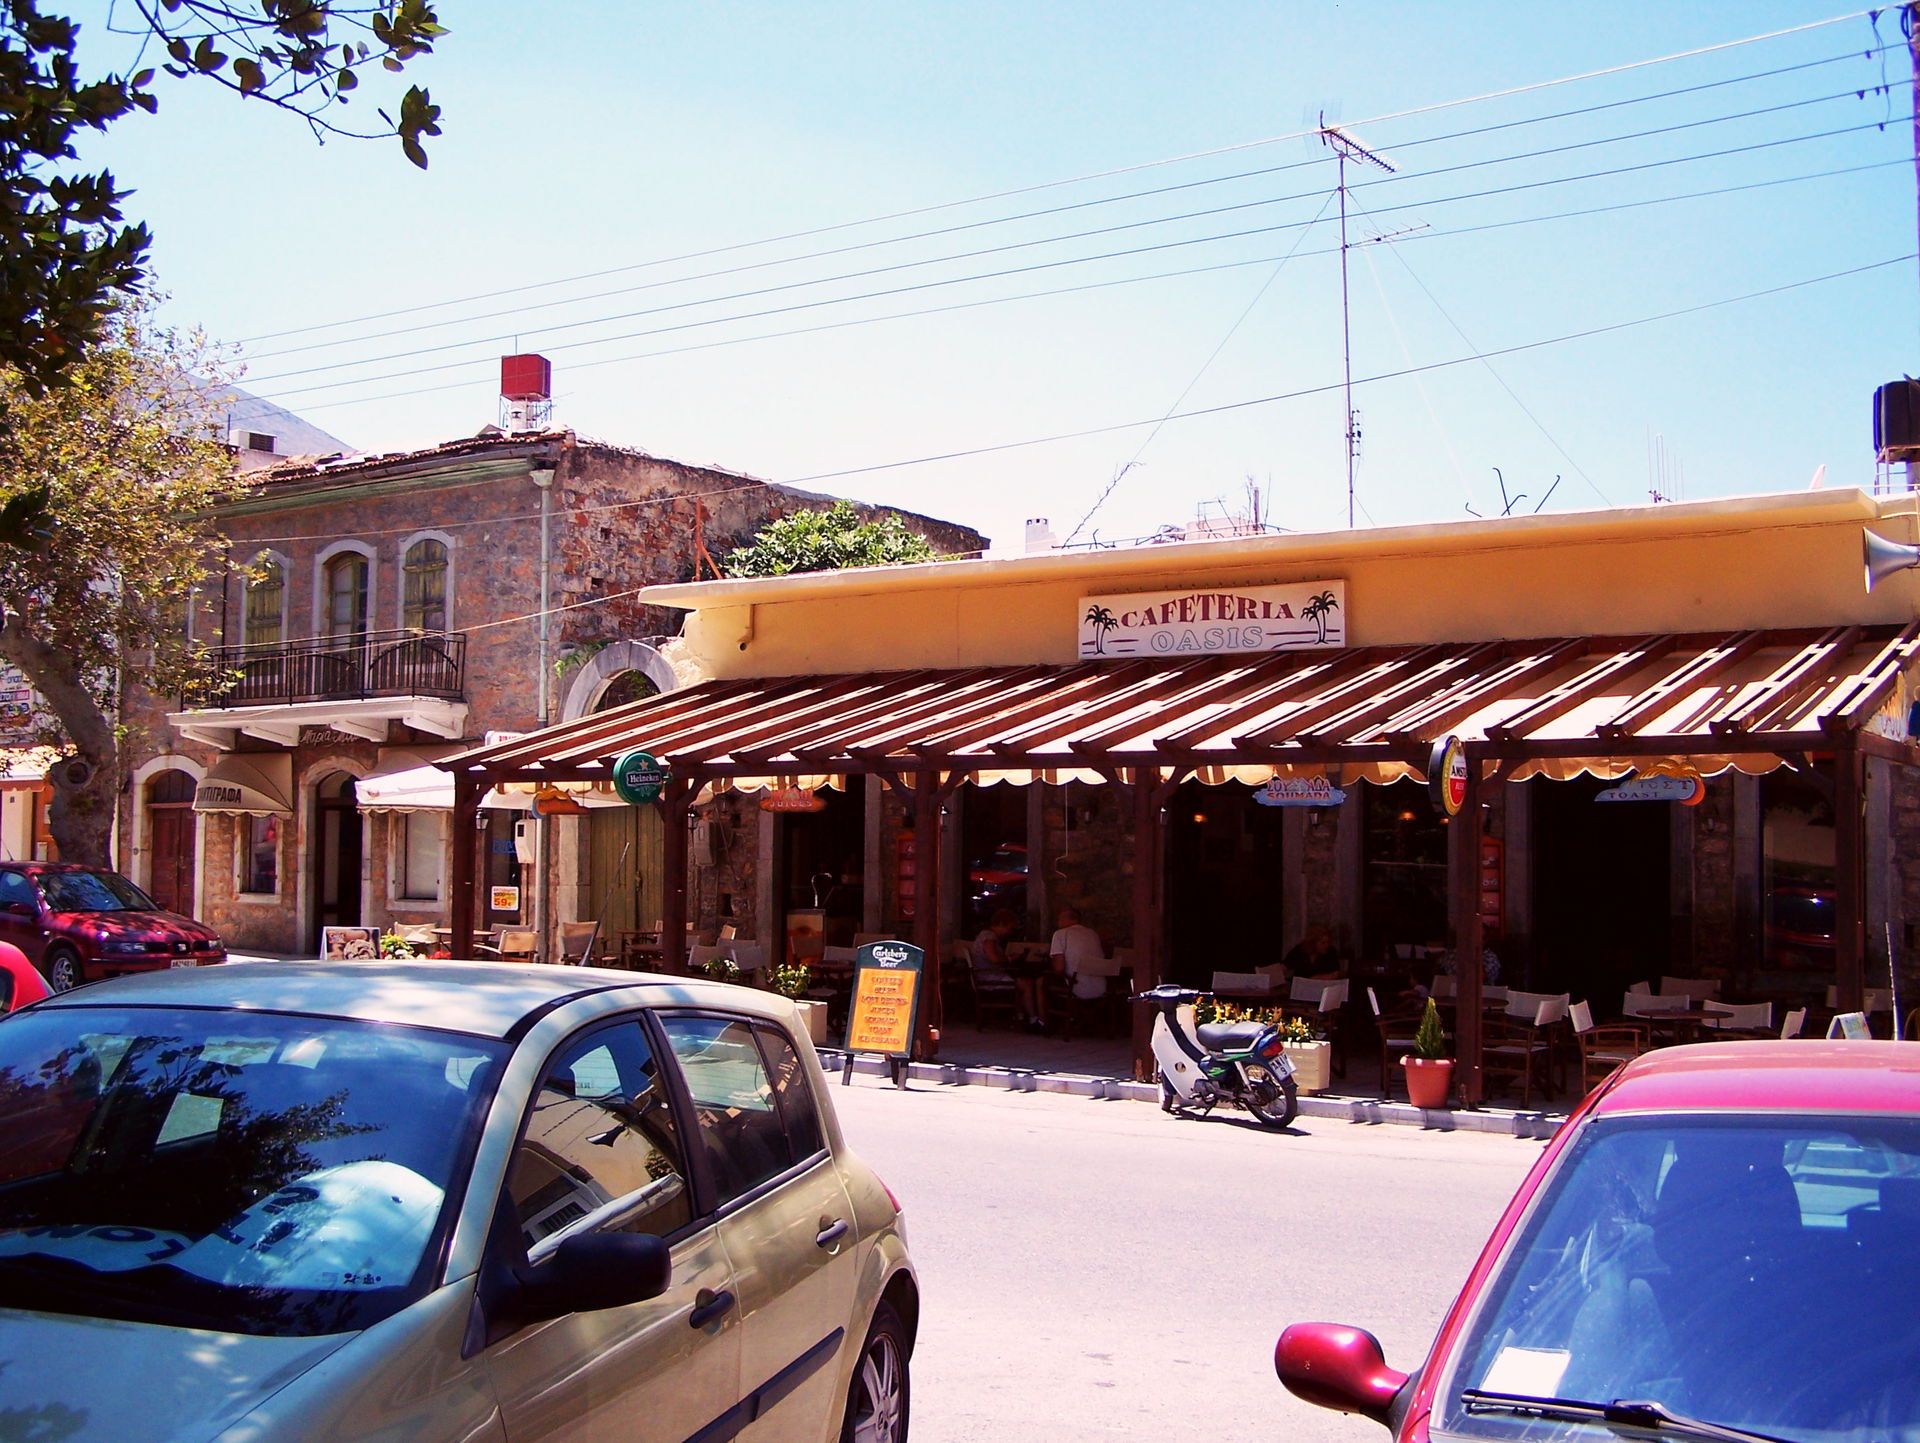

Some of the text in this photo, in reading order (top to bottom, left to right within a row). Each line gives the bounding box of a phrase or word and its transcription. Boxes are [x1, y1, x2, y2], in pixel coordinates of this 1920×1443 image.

[1120, 593, 1296, 628] CAFETERIA
[1150, 626, 1263, 652] OASIS
[630, 774, 660, 783] Heineken
[1267, 792, 1330, 800] SOUMADA
[1609, 791, 1660, 799] TOAST
[872, 945, 908, 961] Carlsberg
[879, 959, 899, 968] Beer
